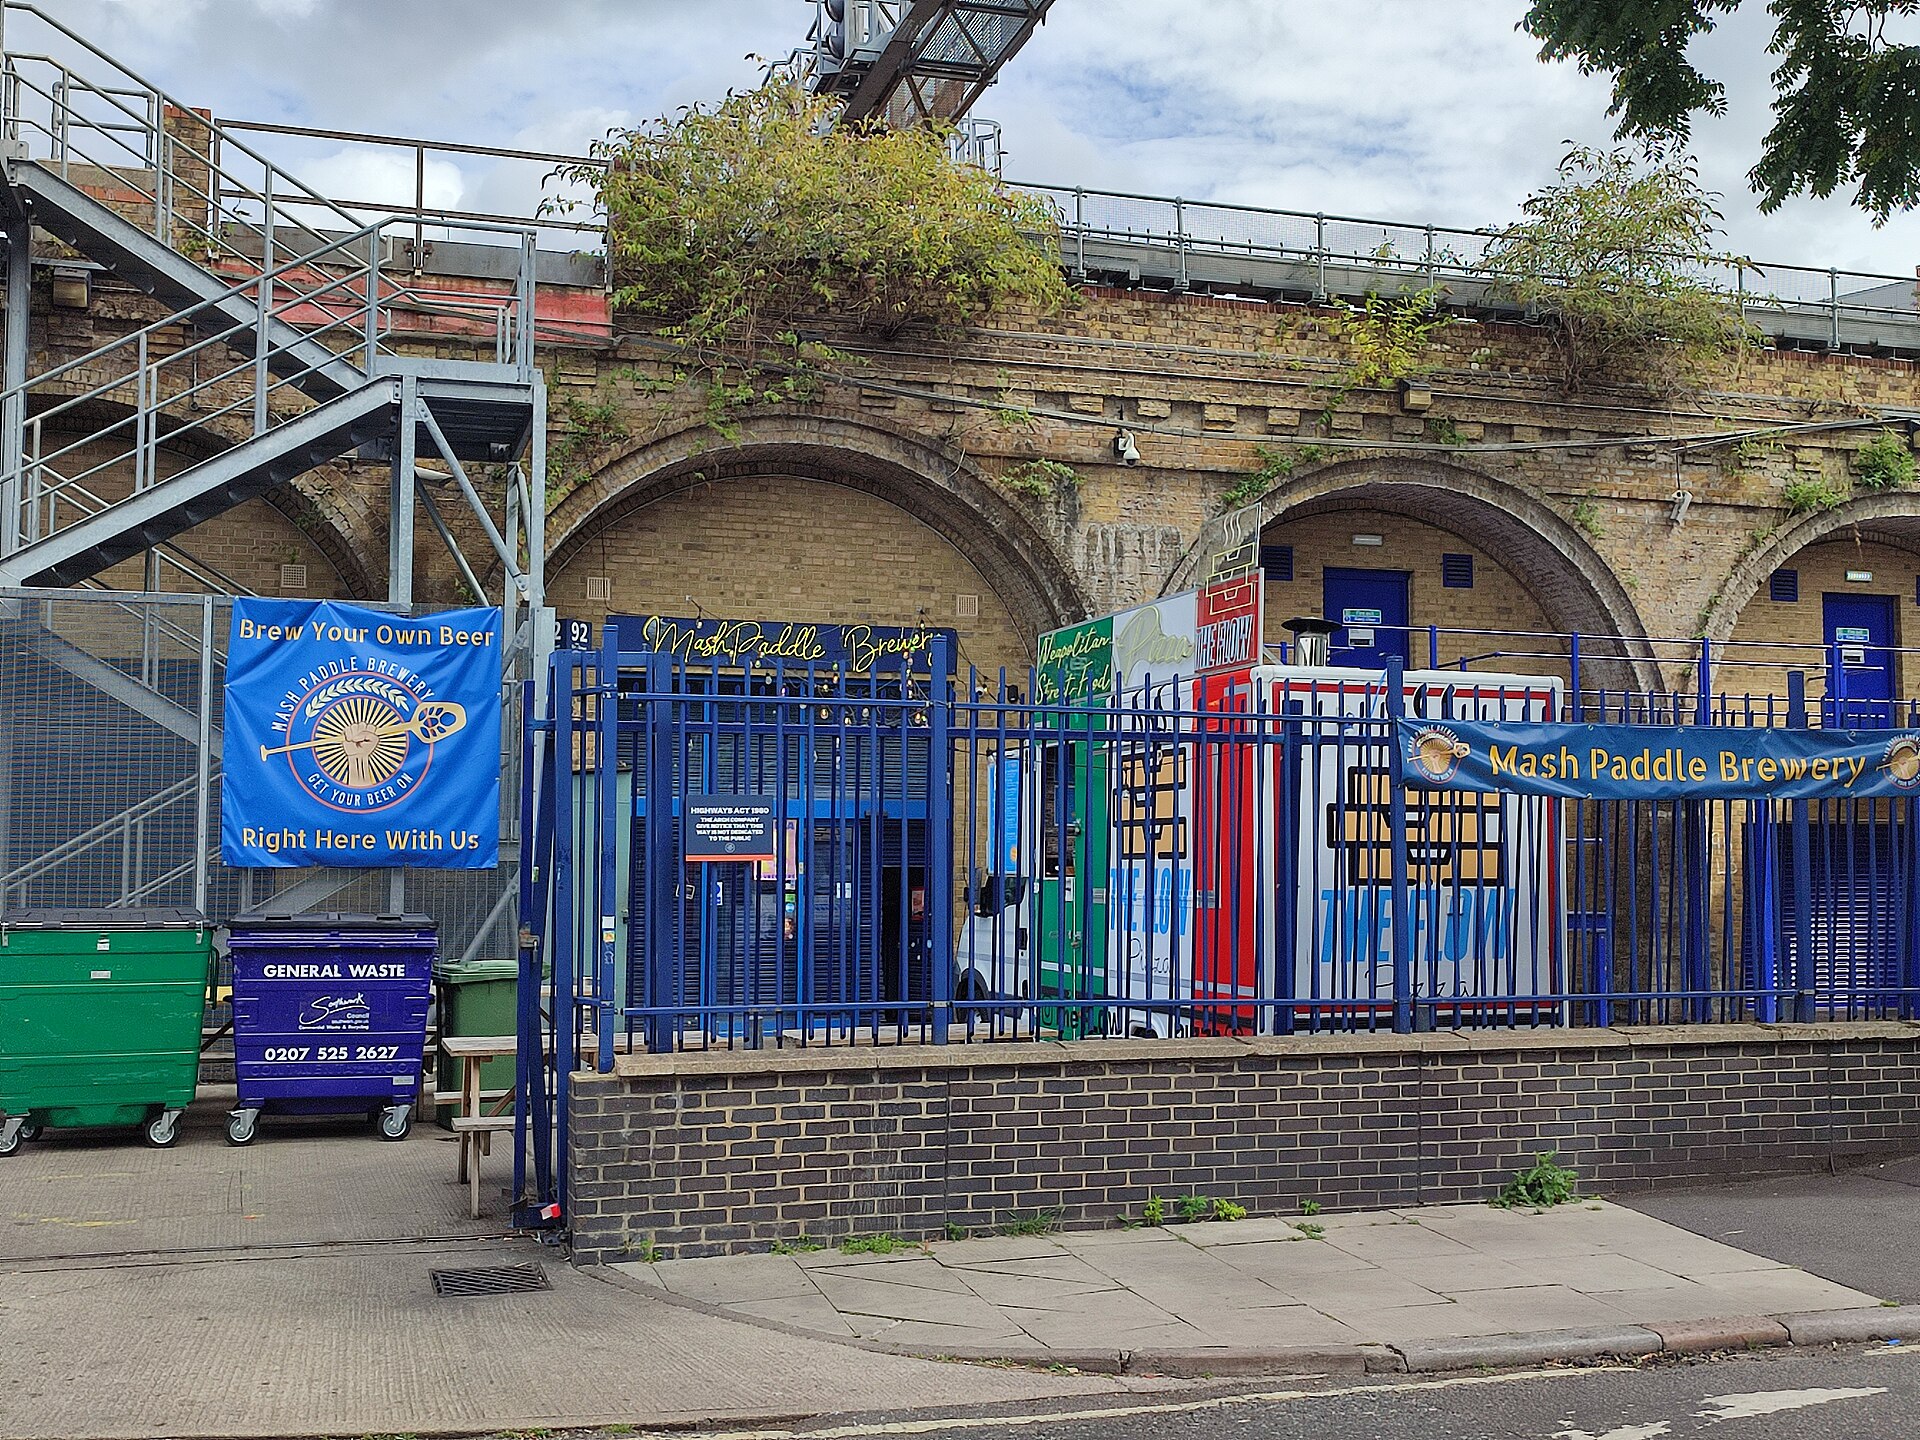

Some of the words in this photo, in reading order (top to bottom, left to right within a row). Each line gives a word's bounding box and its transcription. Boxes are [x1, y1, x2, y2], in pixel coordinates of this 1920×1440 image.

[239, 618, 303, 641] Brew
[312, 621, 369, 643] Your
[376, 625, 431, 646] Own
[439, 626, 494, 647] Beer
[571, 621, 588, 643] 92
[643, 615, 729, 663] Mash
[727, 621, 825, 665] Paddle
[844, 625, 933, 672] Brewer
[1040, 628, 1110, 668] Neapolitan
[1117, 606, 1194, 686] Pizza
[271, 690, 301, 732] MASH
[298, 656, 359, 691] PADDLE
[367, 657, 435, 701] BREWERY
[1035, 673, 1077, 705] Stret
[1078, 661, 1110, 698] Fod
[1489, 745, 1579, 780] Mash
[1591, 748, 1707, 782] Paddle
[1719, 751, 1866, 788] Brewery
[308, 773, 330, 794] GET
[331, 789, 361, 806] YOUR
[367, 785, 397, 806] BEER
[396, 772, 414, 789] ON
[242, 827, 307, 853] Right
[315, 829, 376, 850] Here
[385, 828, 442, 850] With
[450, 830, 479, 850] Us
[263, 965, 342, 978] GENERAL
[349, 964, 406, 977] WASTE
[264, 1047, 311, 1061] 0207
[317, 1046, 348, 1060] 525
[356, 1046, 400, 1059] 2627
